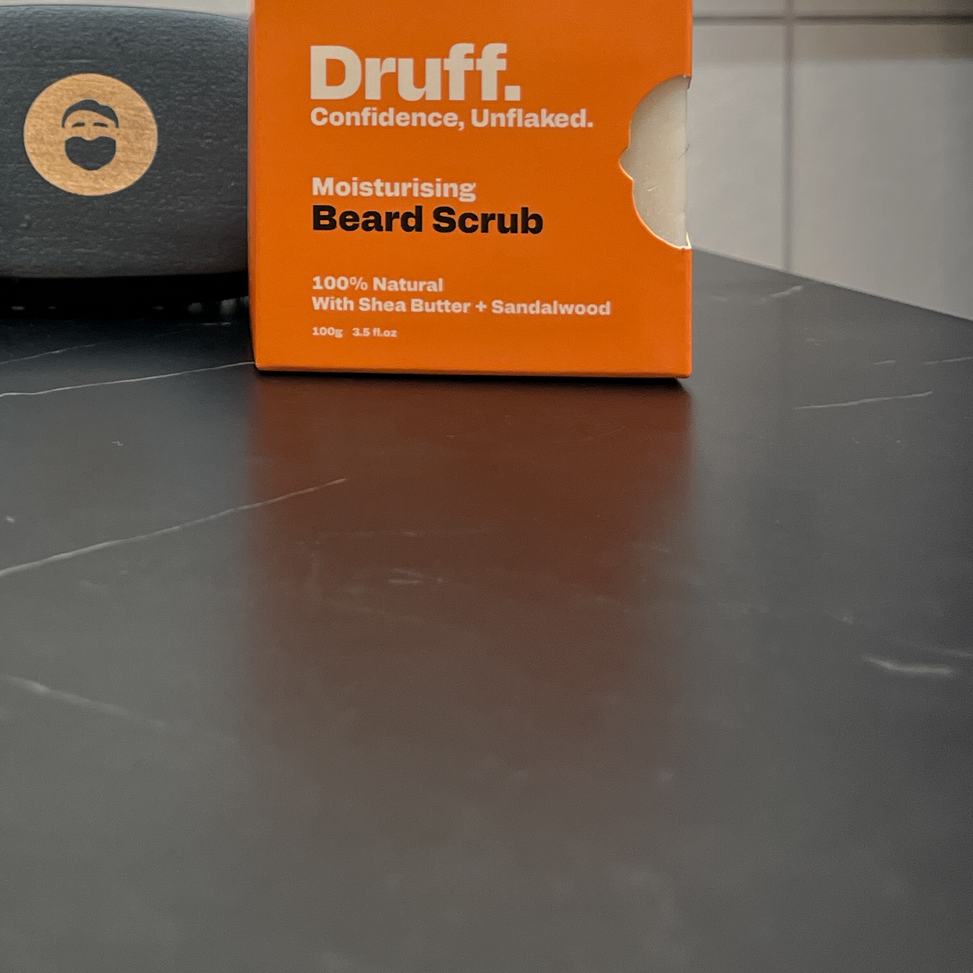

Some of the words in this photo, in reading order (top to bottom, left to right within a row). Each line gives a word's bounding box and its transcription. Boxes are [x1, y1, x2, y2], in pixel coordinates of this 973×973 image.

[309, 42, 521, 102] Druff.
[310, 106, 465, 131] Confidence,
[471, 108, 594, 129] Unflaked.
[311, 177, 476, 202] Moisturising
[312, 204, 423, 233] Beard
[432, 205, 544, 235] Scrub
[312, 276, 368, 291] 100%
[372, 277, 443, 292] Natural
[312, 296, 355, 312] With
[359, 297, 406, 313] Shea
[411, 298, 470, 314] Butter
[491, 299, 611, 316] Sandalwood
[312, 326, 343, 338] 100g
[352, 327, 370, 337] 3.5
